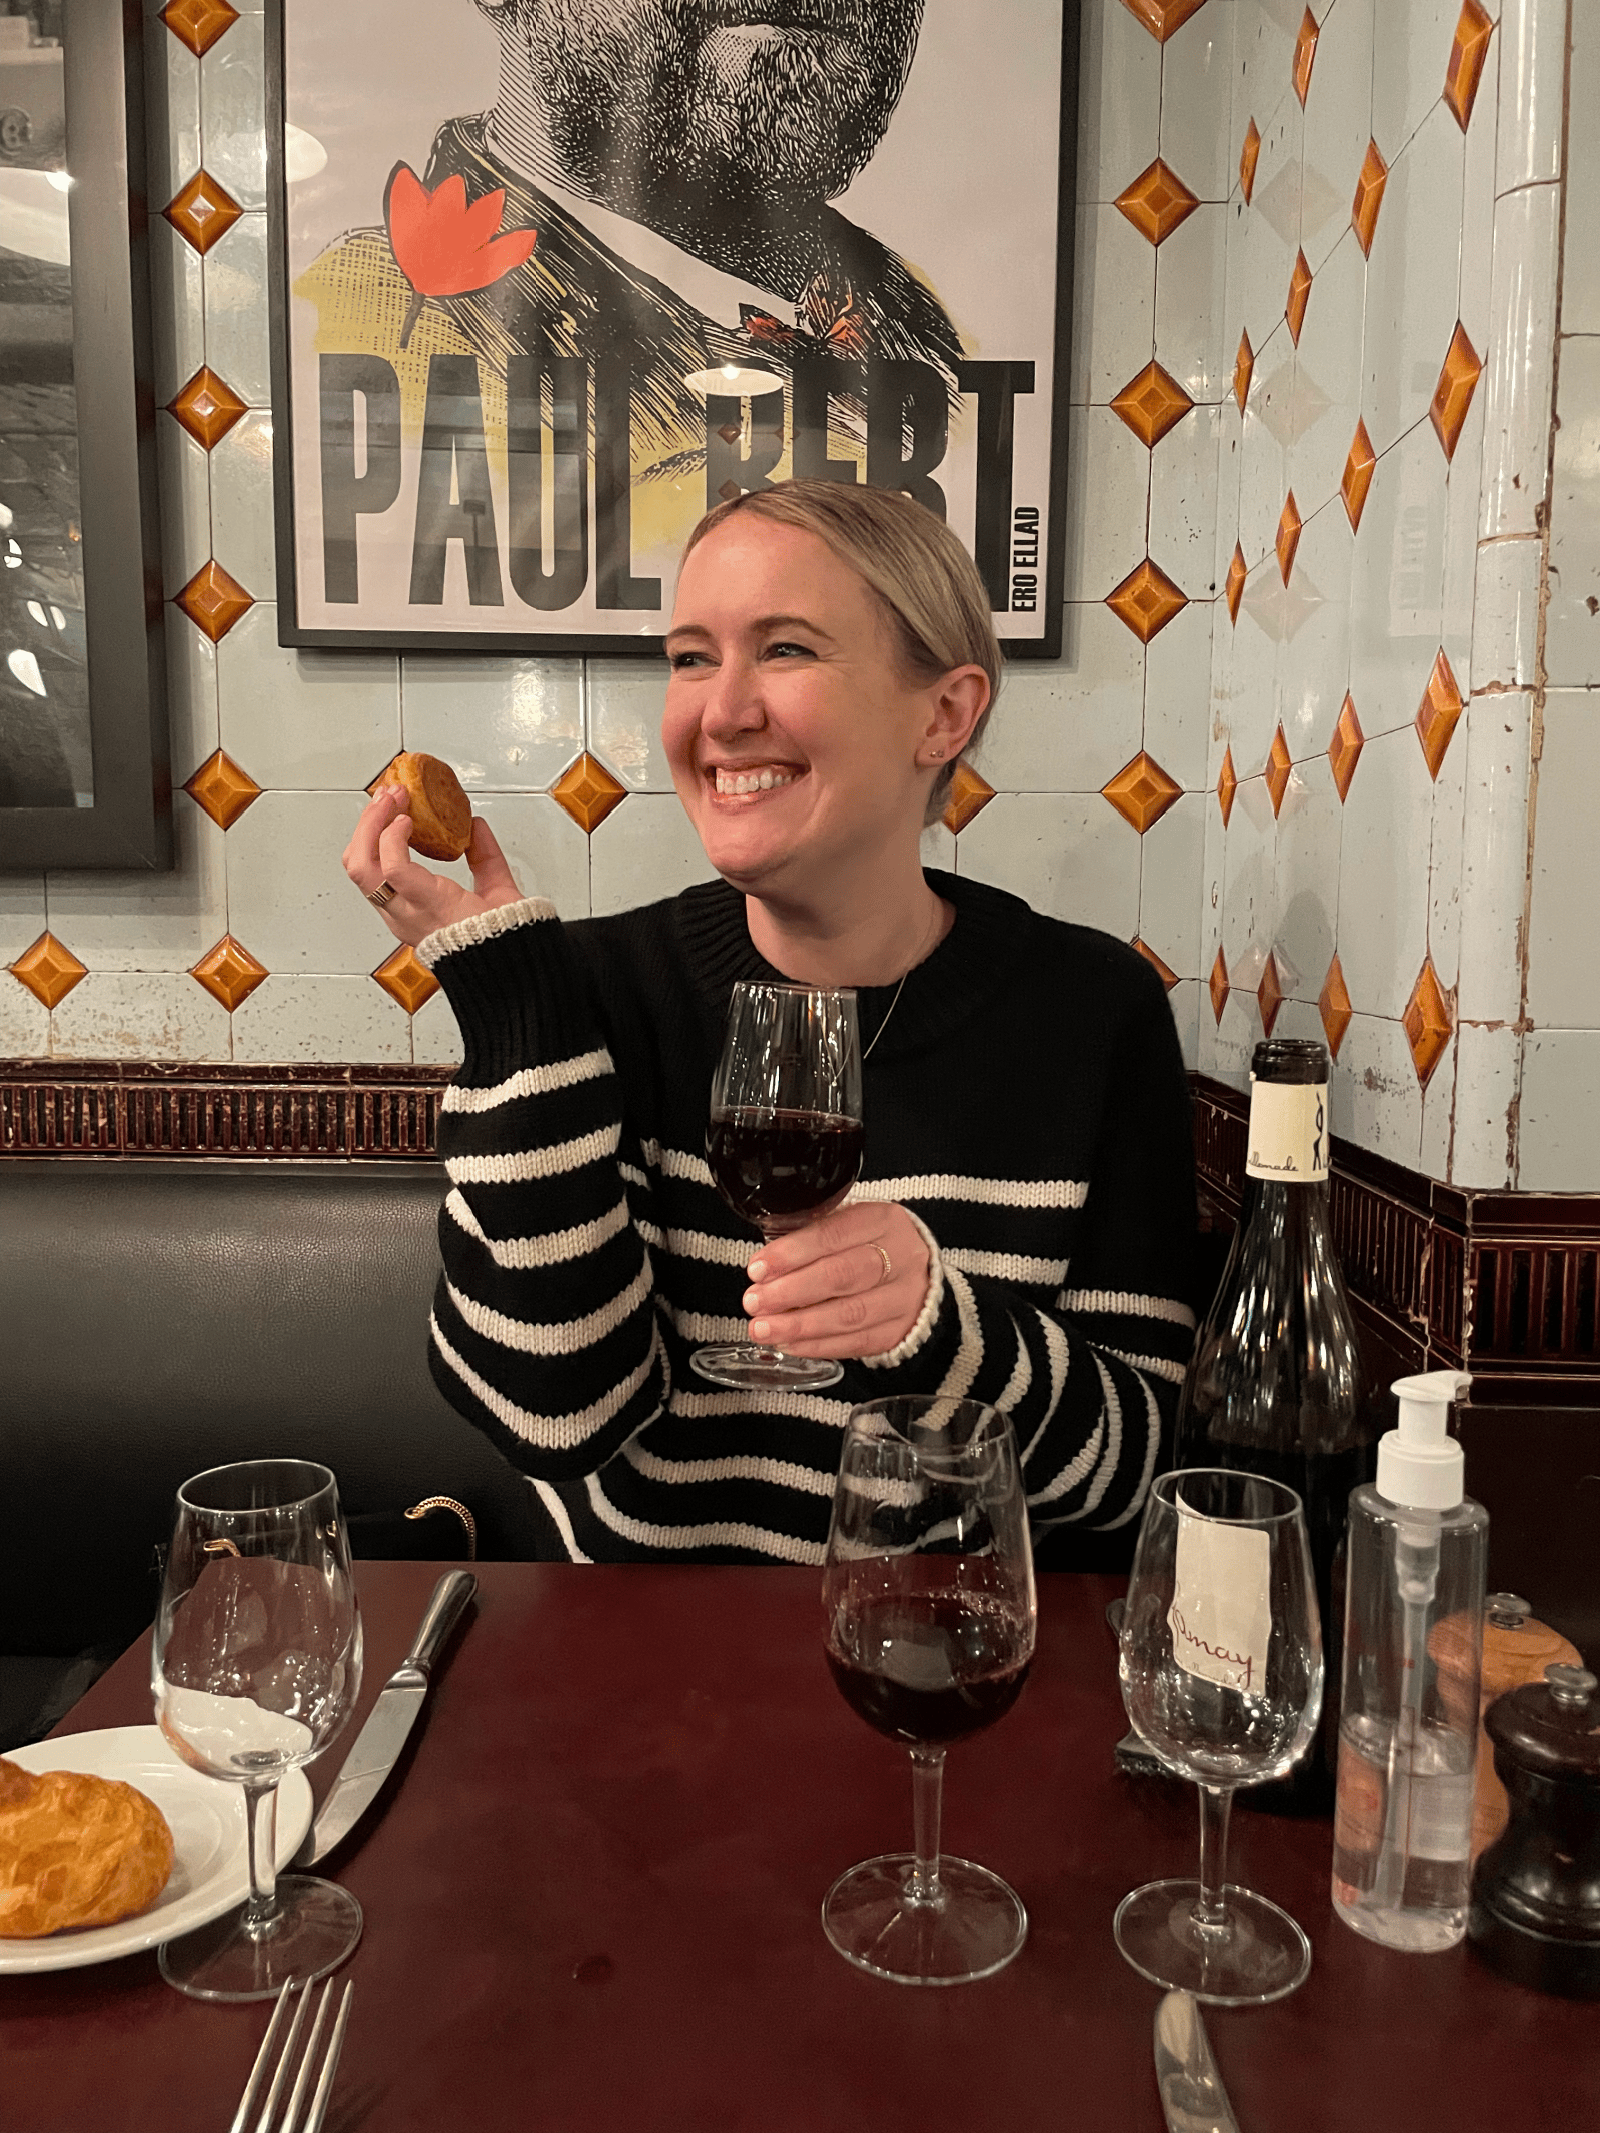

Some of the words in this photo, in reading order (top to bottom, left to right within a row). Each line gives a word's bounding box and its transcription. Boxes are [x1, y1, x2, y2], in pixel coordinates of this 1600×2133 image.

[318, 352, 662, 611] PAUL
[1013, 506, 1039, 568] ELLAD
[1012, 574, 1038, 612] ERO
